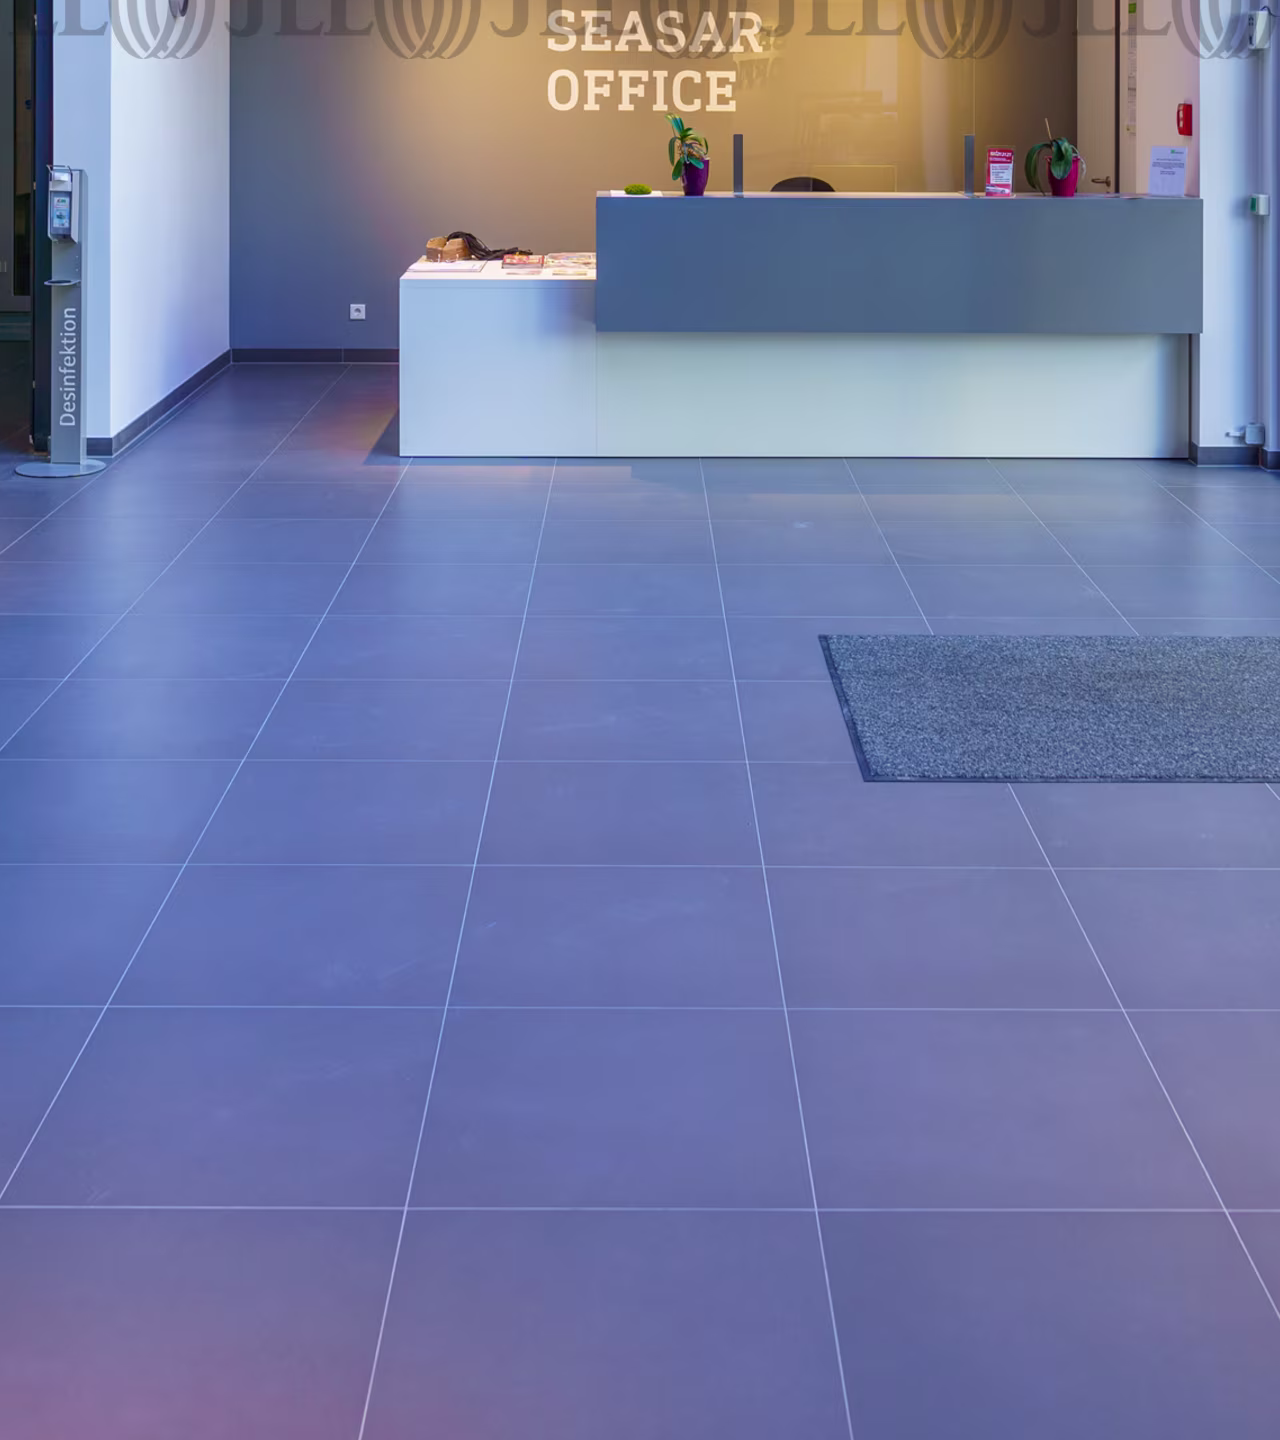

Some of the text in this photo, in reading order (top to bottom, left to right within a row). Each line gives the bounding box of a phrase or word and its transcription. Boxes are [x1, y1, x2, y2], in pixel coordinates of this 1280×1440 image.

[546, 9, 763, 53] SEASAR
[546, 68, 737, 112] OFFICE
[59, 307, 77, 426] Desinfektion
